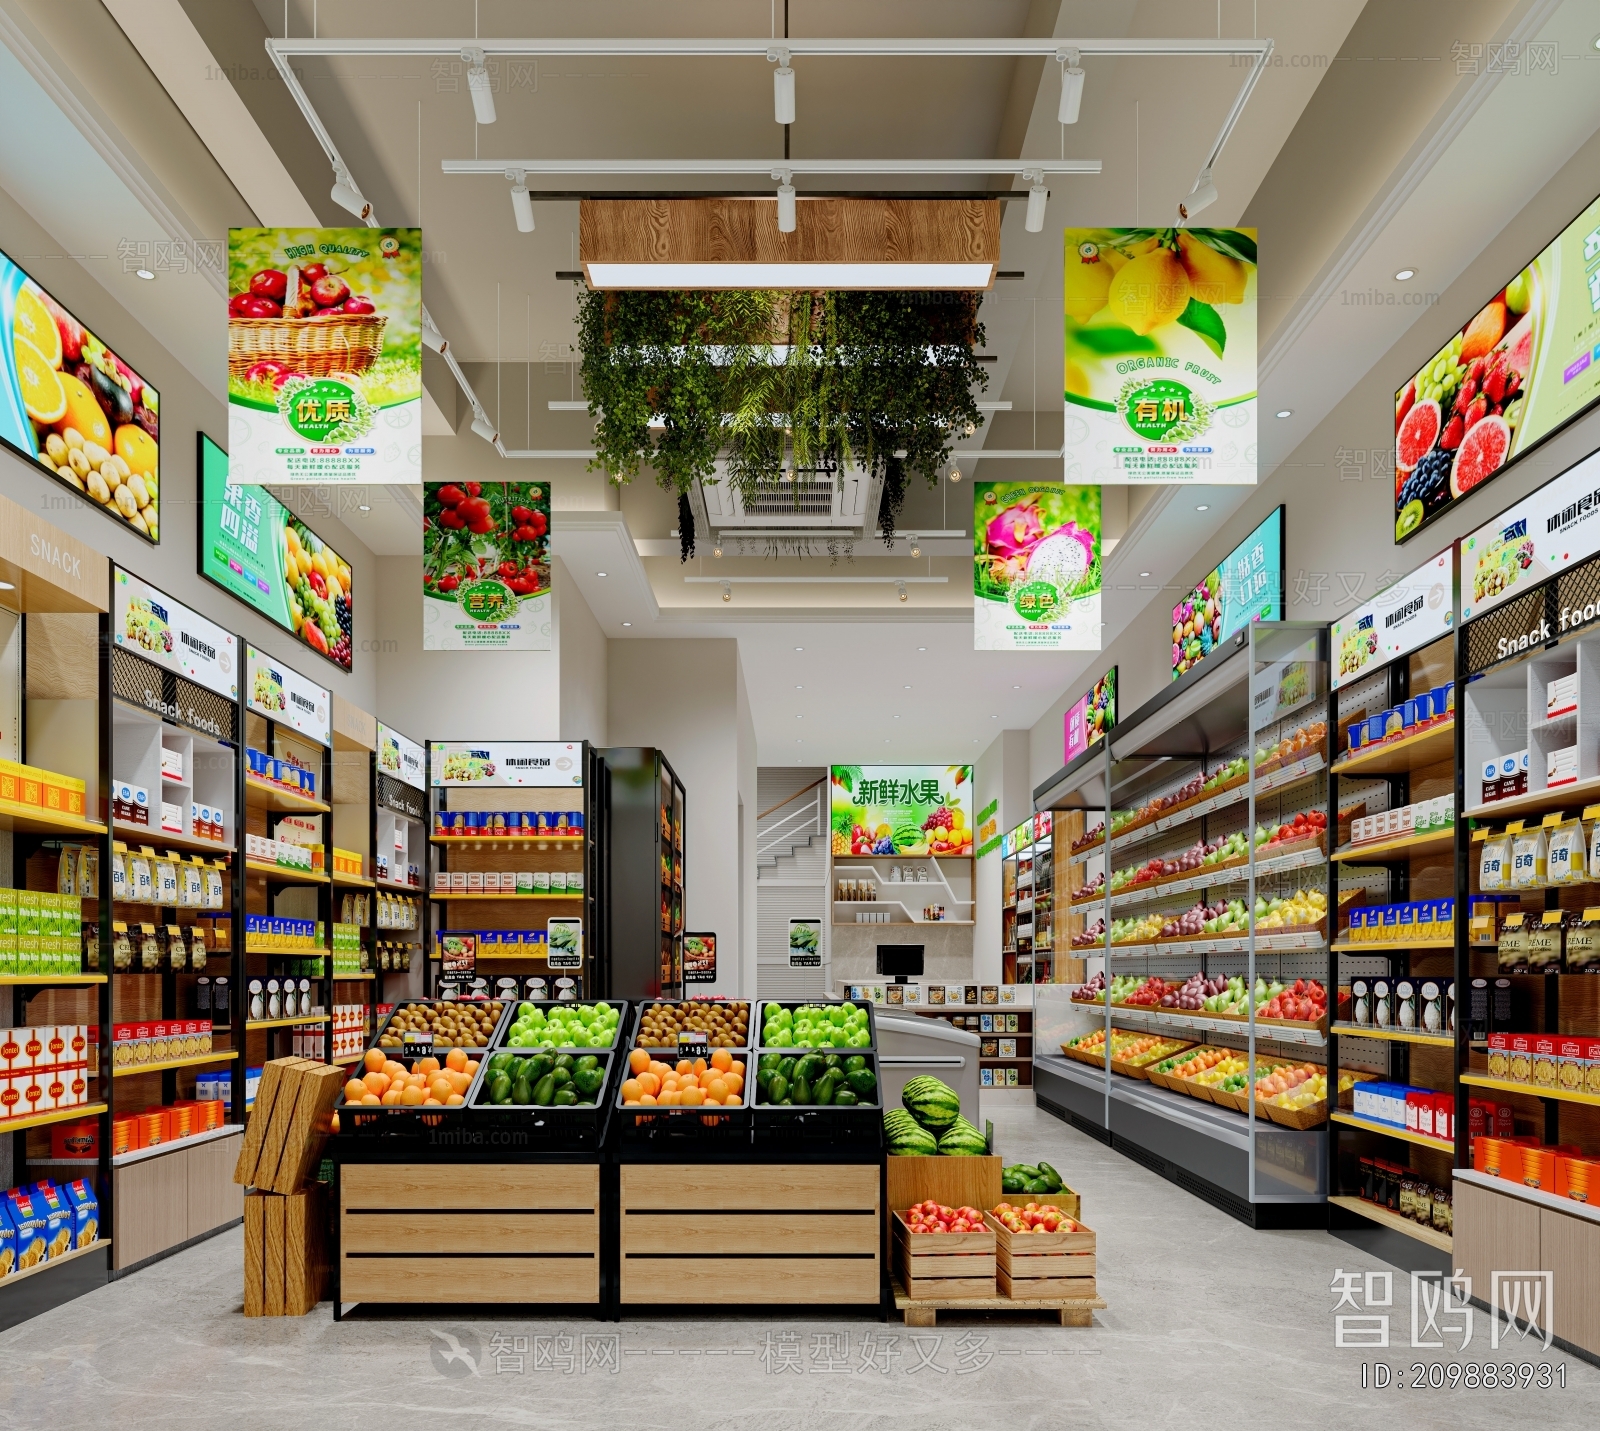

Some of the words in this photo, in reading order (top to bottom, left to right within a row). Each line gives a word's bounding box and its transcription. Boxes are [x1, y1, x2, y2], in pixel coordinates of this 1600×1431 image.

[284, 244, 314, 259] HIGH
[319, 244, 370, 258] QUALITY
[1116, 356, 1179, 375] ORGANIC
[1185, 362, 1222, 385] FRUIT
[296, 398, 351, 423] 优质
[1134, 397, 1189, 423] 有机
[224, 478, 262, 526] 果香
[495, 496, 531, 505] NUTRITION
[1559, 520, 1579, 534] SNACK
[1579, 508, 1599, 523] FOODS
[220, 503, 260, 555] 四溢
[30, 533, 81, 580] SNACK
[468, 593, 504, 609] 营养
[1020, 594, 1055, 609] 绿色
[1385, 595, 1424, 628] 休闲食品
[1497, 620, 1551, 659] Snack
[1559, 601, 1600, 632] foo
[181, 631, 216, 660] 休闲食品
[144, 690, 182, 719] Snack
[187, 705, 221, 735] foods
[506, 758, 550, 766] 休闲食品
[852, 778, 945, 806] 新鲜水果
[1515, 854, 1534, 869] 百奇
[1551, 848, 1569, 864] 百奇
[1483, 859, 1501, 874] 百奇
[0, 892, 16, 902] resh
[19, 892, 39, 905] Fresh
[41, 894, 60, 907] Fresh
[63, 897, 81, 909] Fresh
[0, 938, 16, 948] resh
[19, 938, 39, 948] Fresh
[41, 939, 60, 949] Fresh
[63, 940, 81, 950] Fresh
[1528, 939, 1552, 947] REME
[1567, 937, 1593, 945] REME
